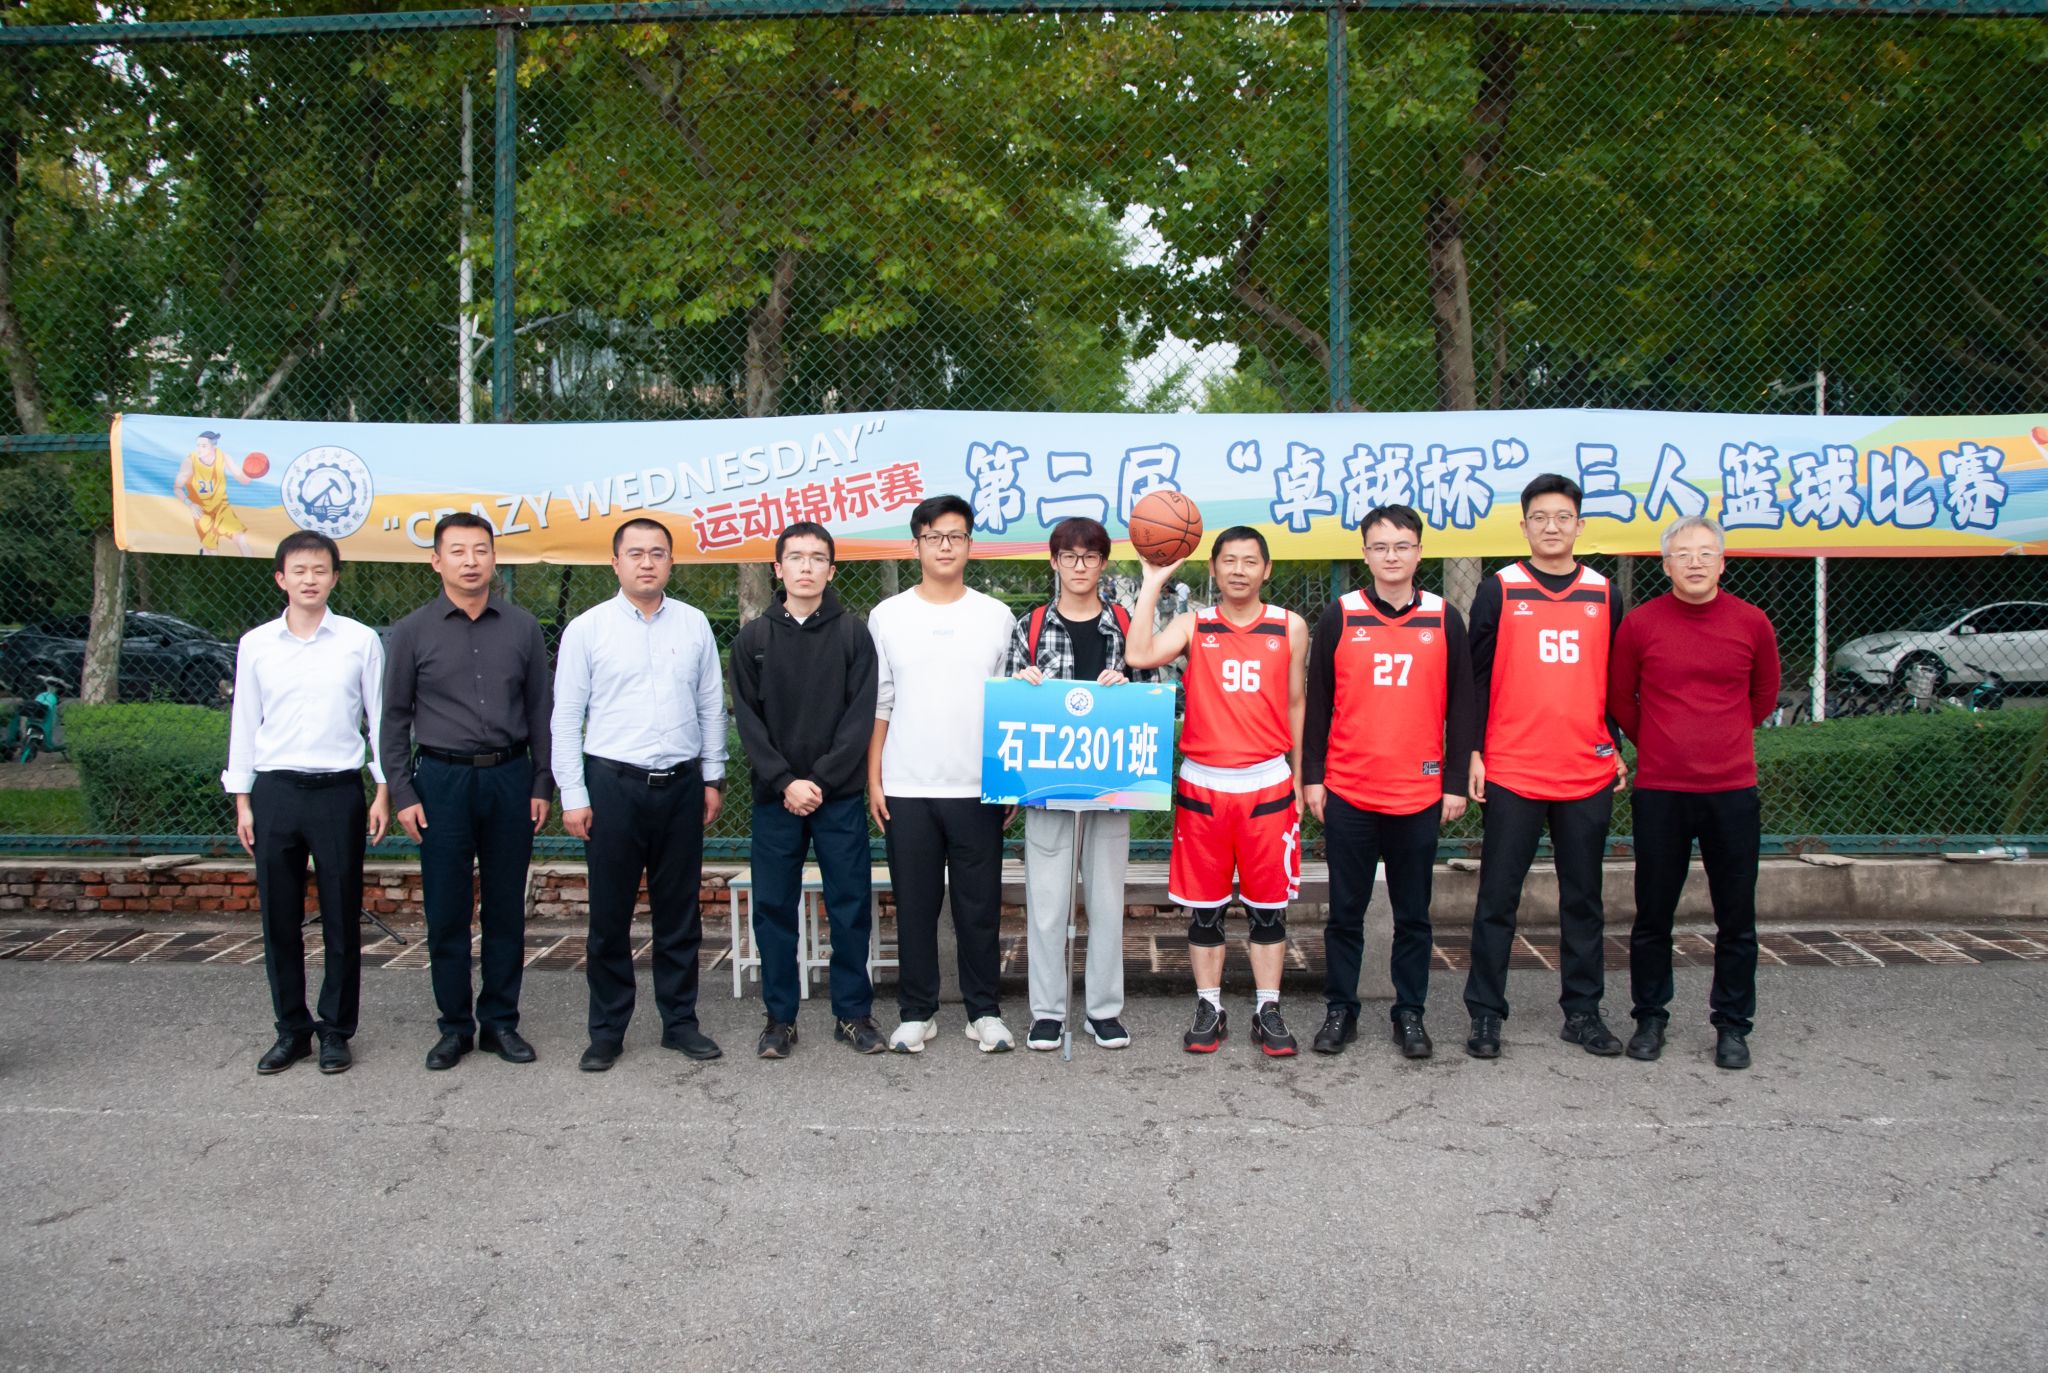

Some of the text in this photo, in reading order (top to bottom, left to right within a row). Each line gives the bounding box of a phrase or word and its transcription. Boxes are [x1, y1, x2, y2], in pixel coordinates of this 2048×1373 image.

[198, 480, 214, 493] 21
[383, 418, 885, 548] “CAZY WEDNESDAY”
[693, 460, 926, 551] 运动锦标赛
[1538, 629, 1580, 664] 66
[1221, 659, 1261, 693] 96
[1373, 653, 1413, 687] 27
[997, 720, 1159, 778] 石工2301班
